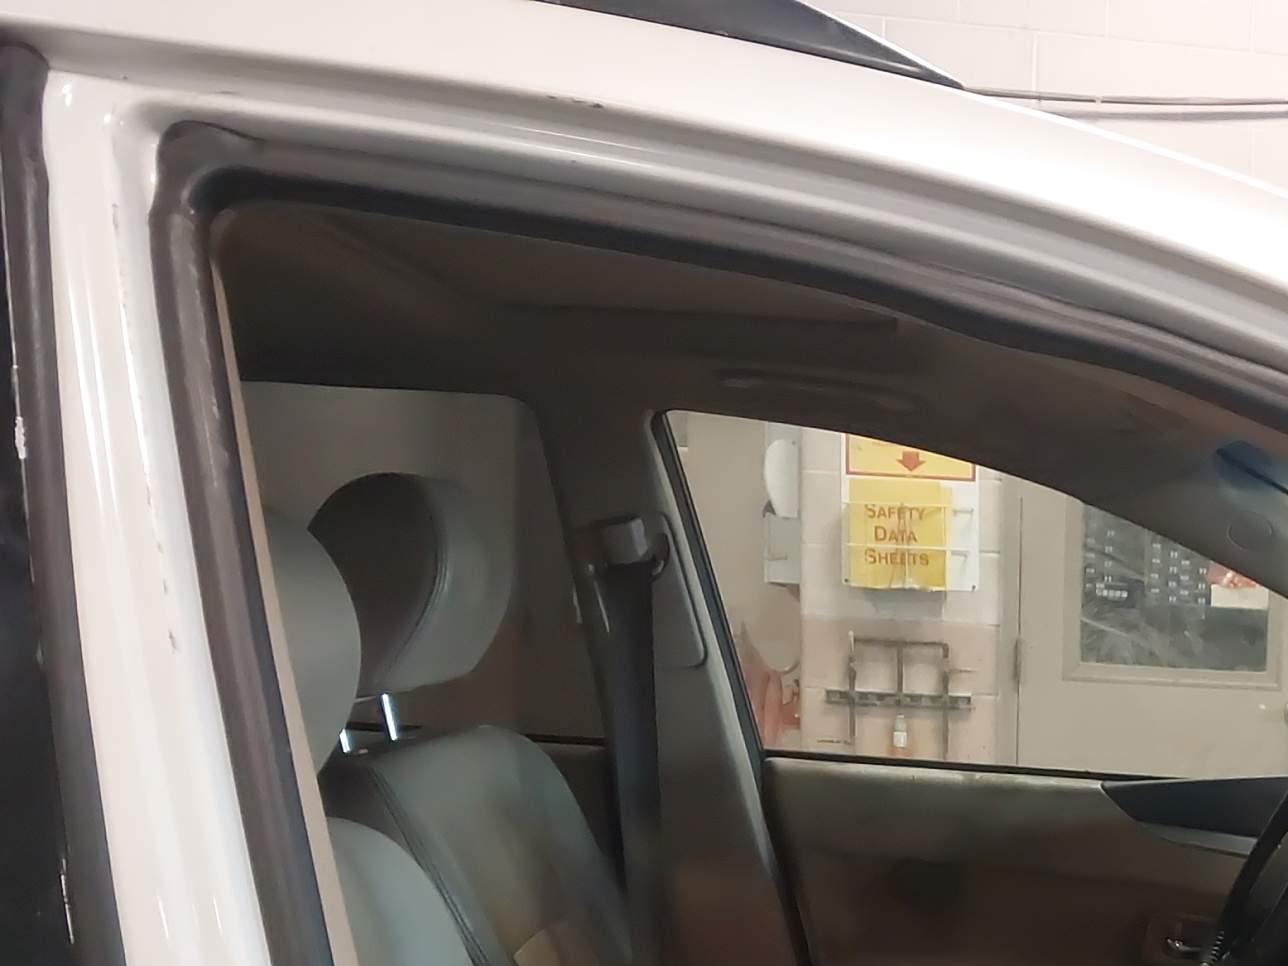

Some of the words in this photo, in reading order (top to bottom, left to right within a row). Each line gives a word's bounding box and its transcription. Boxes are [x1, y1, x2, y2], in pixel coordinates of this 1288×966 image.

[864, 503, 926, 520] SAFETY
[874, 525, 918, 543] DATA
[864, 547, 930, 567] SHEETS
